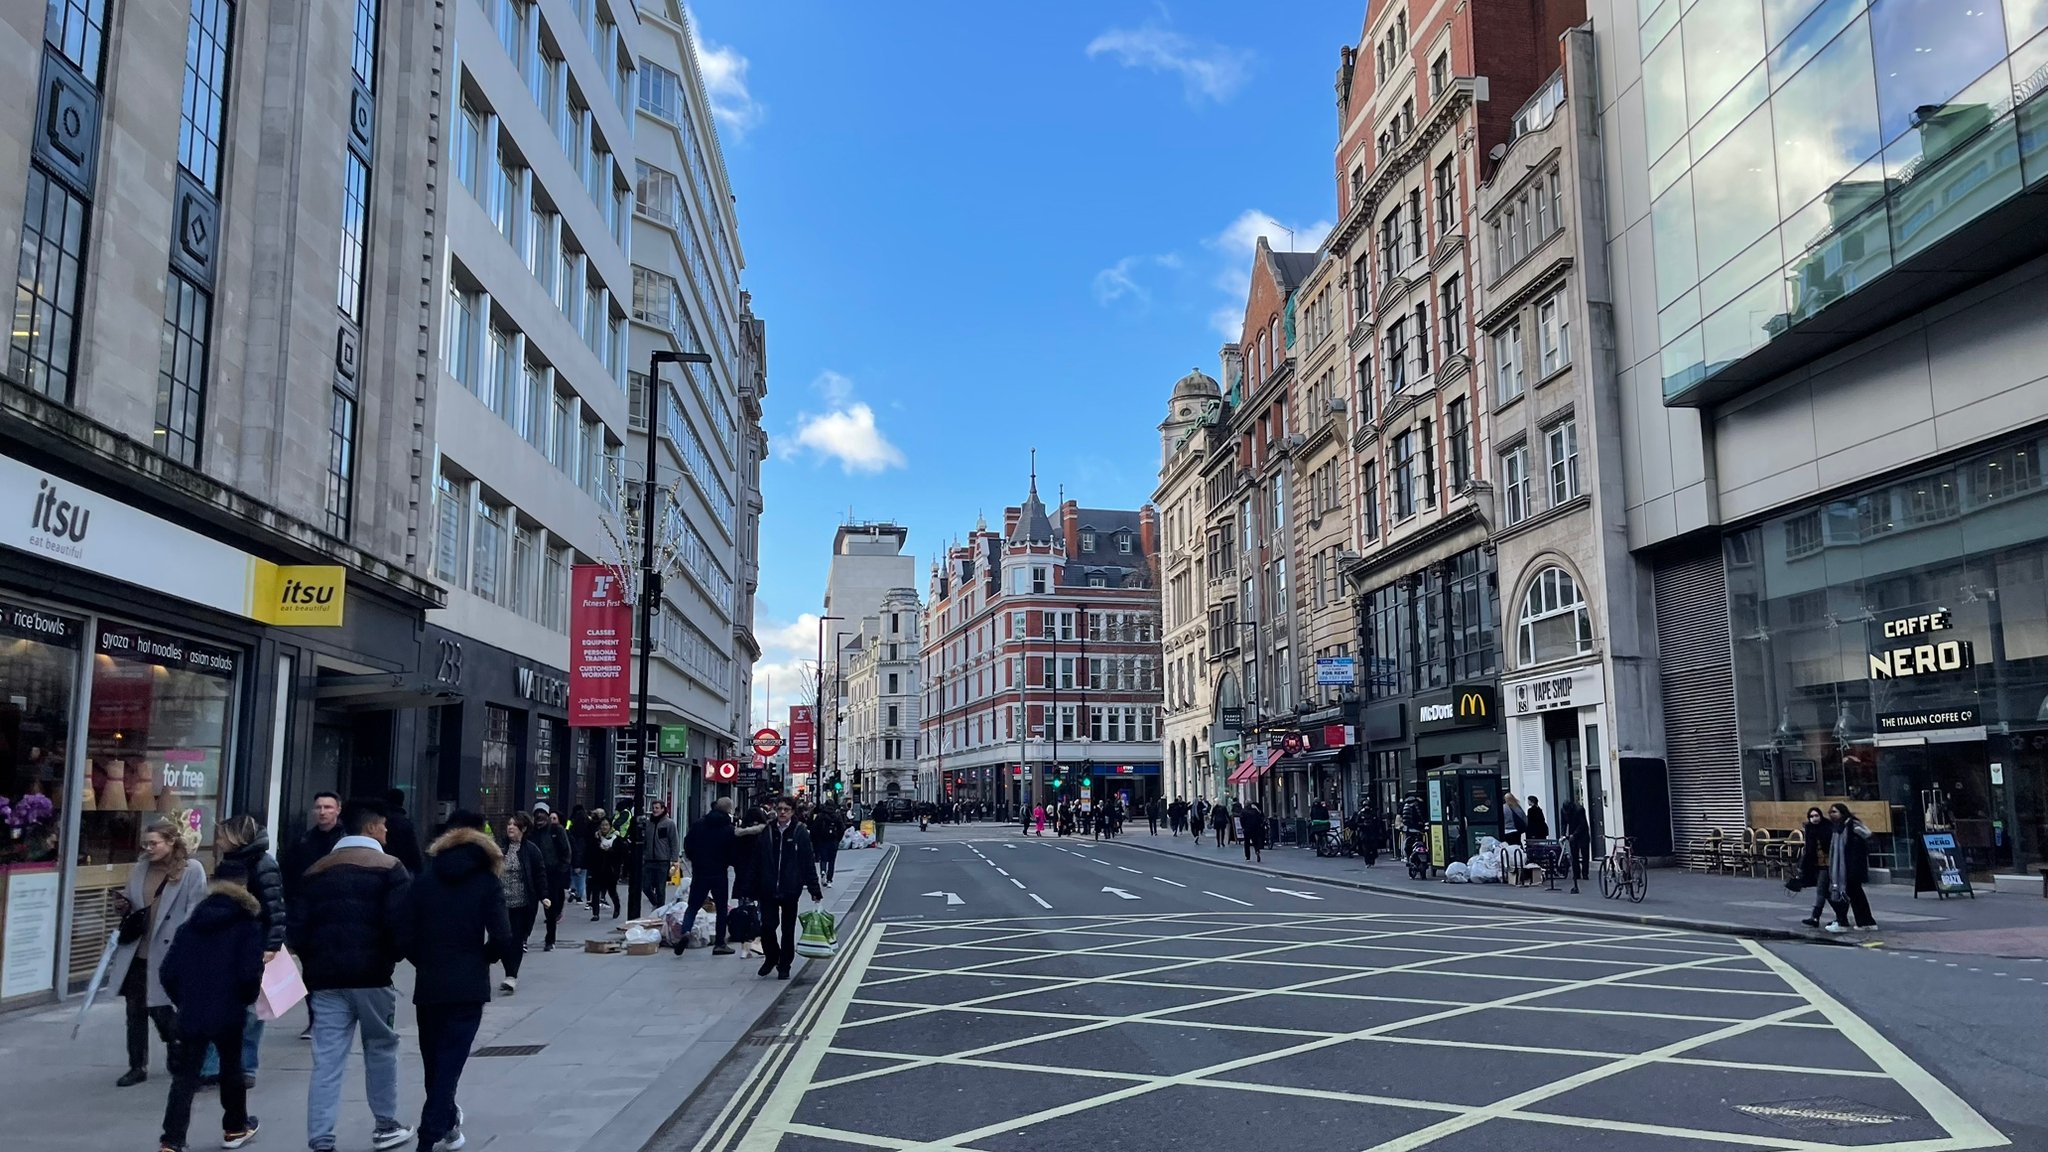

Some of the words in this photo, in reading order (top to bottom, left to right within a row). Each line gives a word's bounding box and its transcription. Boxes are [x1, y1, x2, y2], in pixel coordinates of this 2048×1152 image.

[31, 478, 90, 542] itsu
[29, 535, 44, 548] eat
[45, 538, 83, 559] beautiful
[281, 579, 334, 604] itsu
[14, 609, 34, 629] rice
[35, 612, 65, 636] bowls
[102, 632, 129, 649] gyoza
[137, 636, 151, 653] hot
[152, 643, 183, 660] noodles
[189, 650, 209, 666] asian
[210, 654, 233, 670] salads
[437, 638, 463, 687] 233
[1869, 640, 1961, 680] NERO
[514, 666, 570, 709] WATERST
[1533, 681, 1552, 702] VAPE
[1552, 677, 1573, 699] SHOP
[1881, 717, 1896, 728] THE
[1896, 715, 1928, 727] ITALIAN
[1929, 712, 1959, 724] COFFEE
[163, 763, 180, 787] for
[182, 764, 205, 788] free
